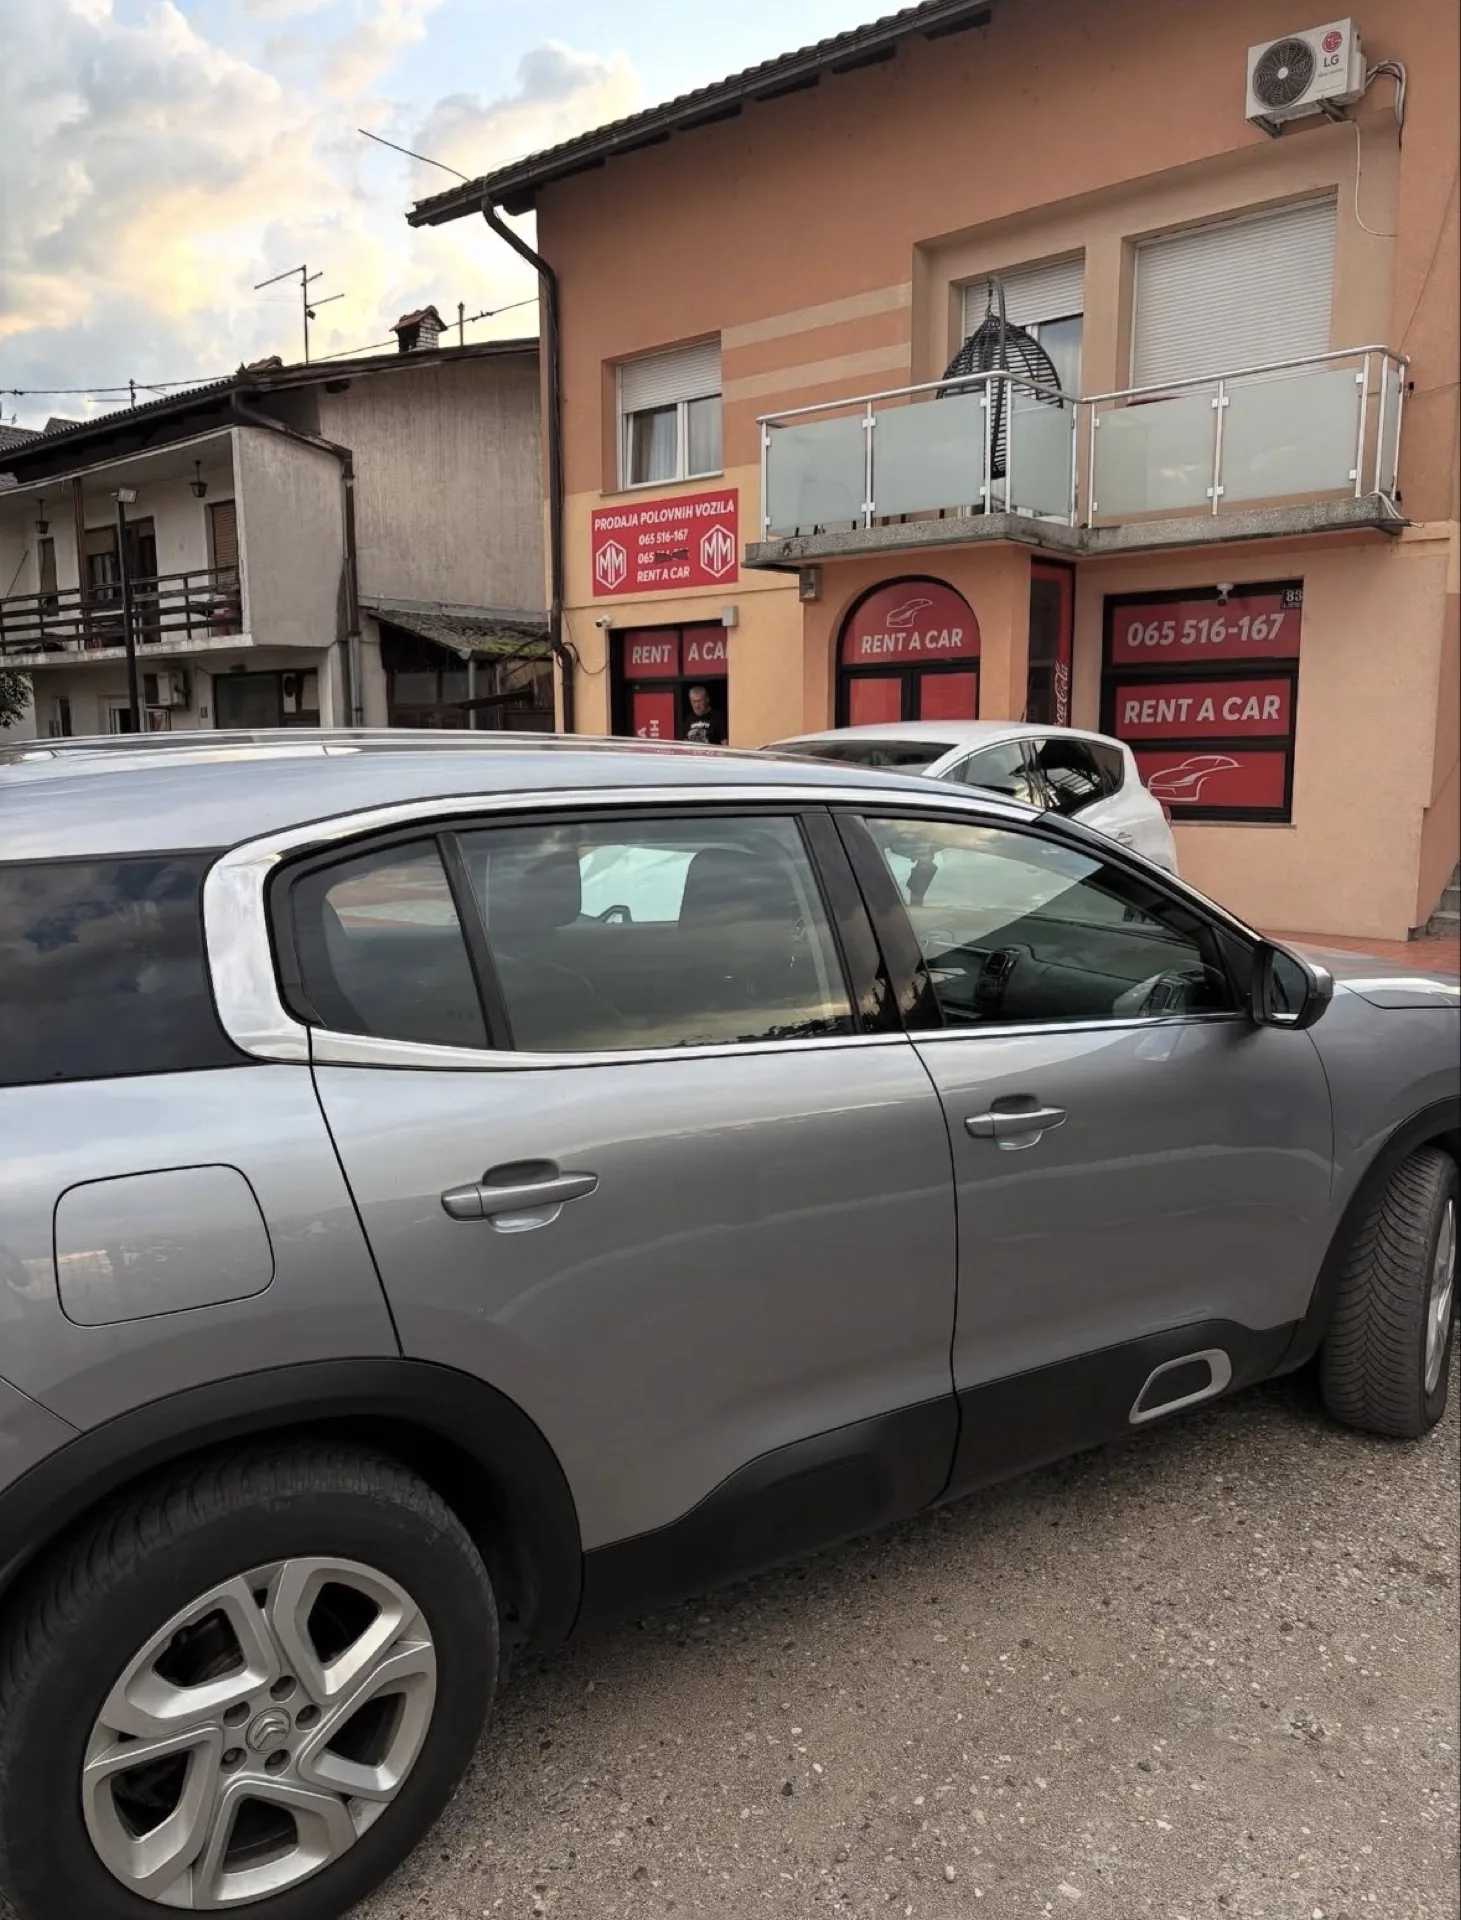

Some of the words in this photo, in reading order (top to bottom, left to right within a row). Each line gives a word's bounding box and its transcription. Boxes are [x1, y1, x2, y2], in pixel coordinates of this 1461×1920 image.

[1323, 54, 1340, 68] LG
[594, 513, 639, 531] PRODAJA
[640, 505, 694, 525] POLOVNIH
[695, 499, 735, 516] VOZILA
[638, 533, 655, 546] 065
[656, 528, 689, 544] 516-167
[637, 552, 654, 565] 065
[637, 569, 661, 583] RENT
[661, 568, 669, 580] A
[670, 566, 691, 579] CAR
[1285, 589, 1302, 602] 83
[1126, 620, 1176, 647] 065
[1180, 612, 1285, 645] 516-167
[861, 632, 907, 654] RENT
[908, 631, 921, 651] A
[925, 628, 963, 649] CAR
[632, 645, 672, 664] RENT
[688, 642, 699, 661] A
[702, 640, 728, 660] CA
[1123, 698, 1193, 725] RENT
[1196, 697, 1215, 722] A
[1222, 694, 1281, 721] CAR
